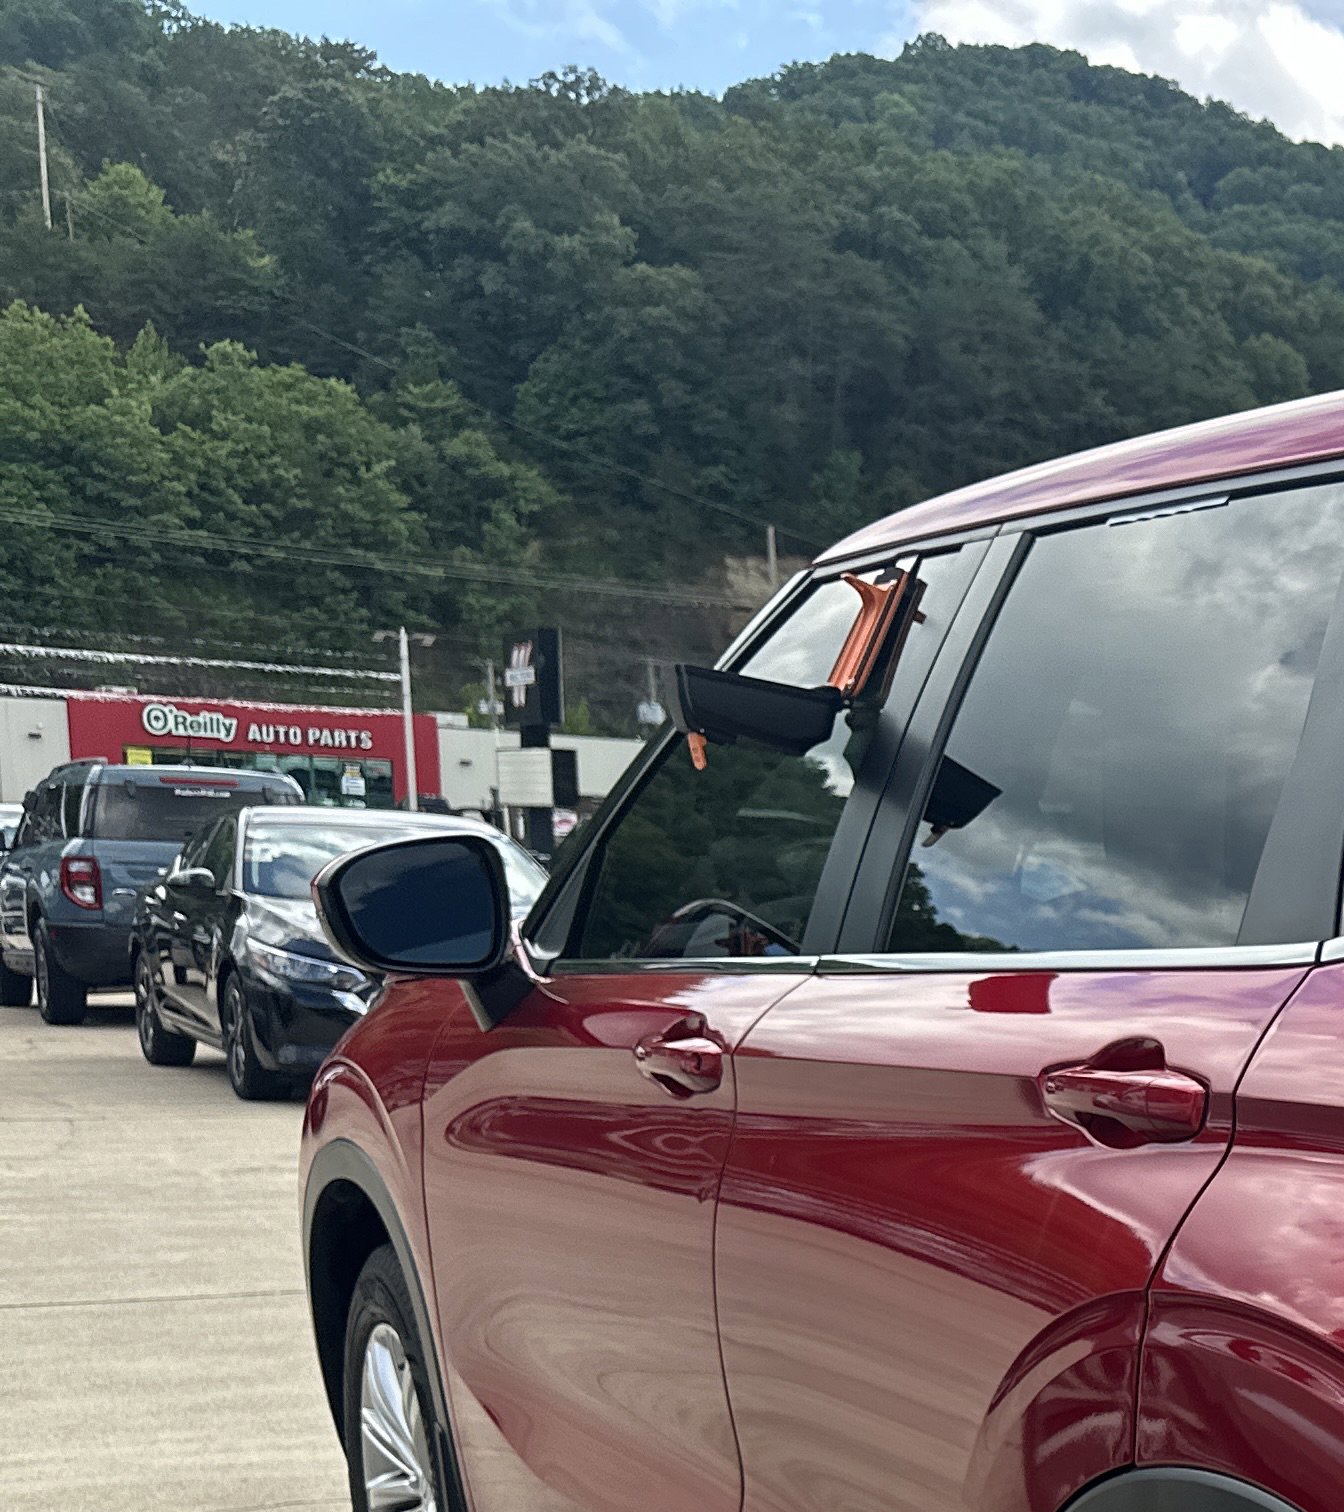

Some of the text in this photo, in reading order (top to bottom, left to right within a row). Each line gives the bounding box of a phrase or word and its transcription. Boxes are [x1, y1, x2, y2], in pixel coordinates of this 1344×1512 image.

[145, 706, 373, 750] O'Reilly AUTO PARTS
